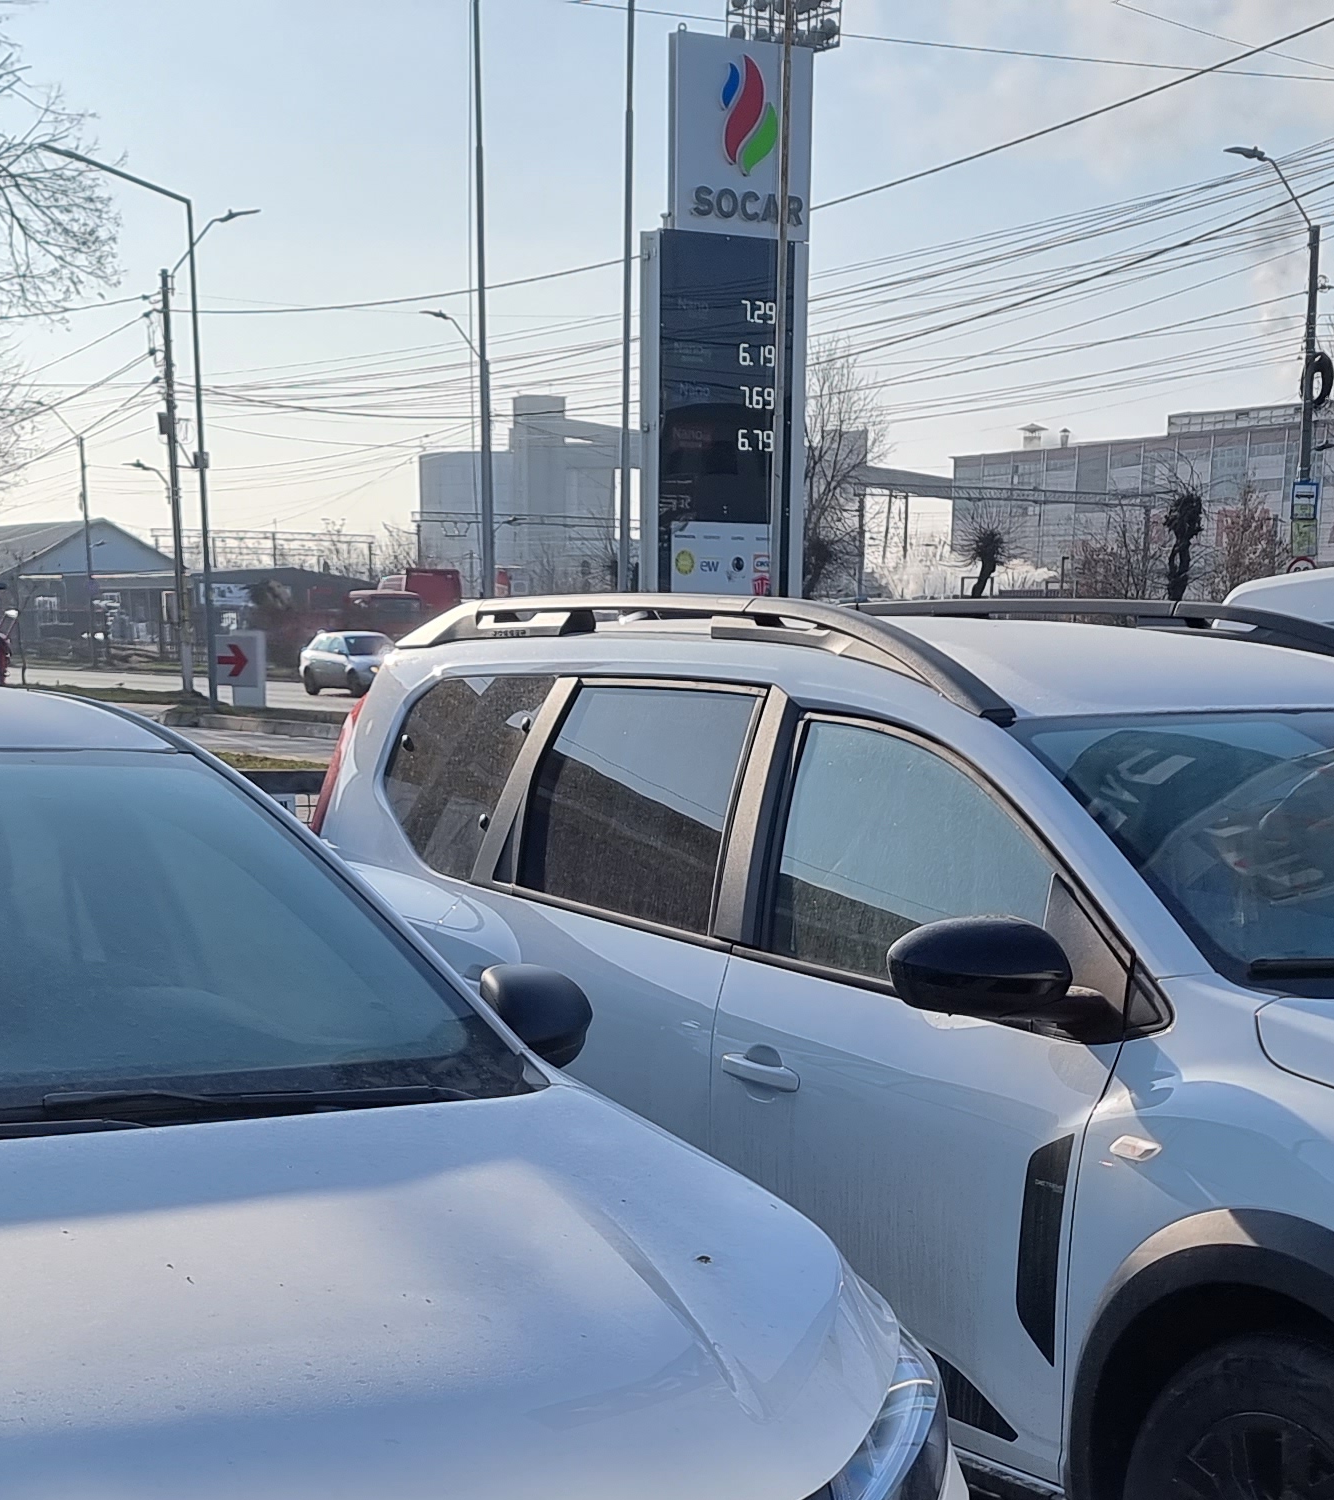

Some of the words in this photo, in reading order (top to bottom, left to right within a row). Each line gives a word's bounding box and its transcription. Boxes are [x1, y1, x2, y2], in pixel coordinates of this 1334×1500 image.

[692, 185, 804, 226] SOCAR
[741, 300, 776, 324] 7.29
[739, 343, 776, 367] 6.19
[740, 386, 775, 410] 7.69
[737, 429, 774, 452] 6.79
